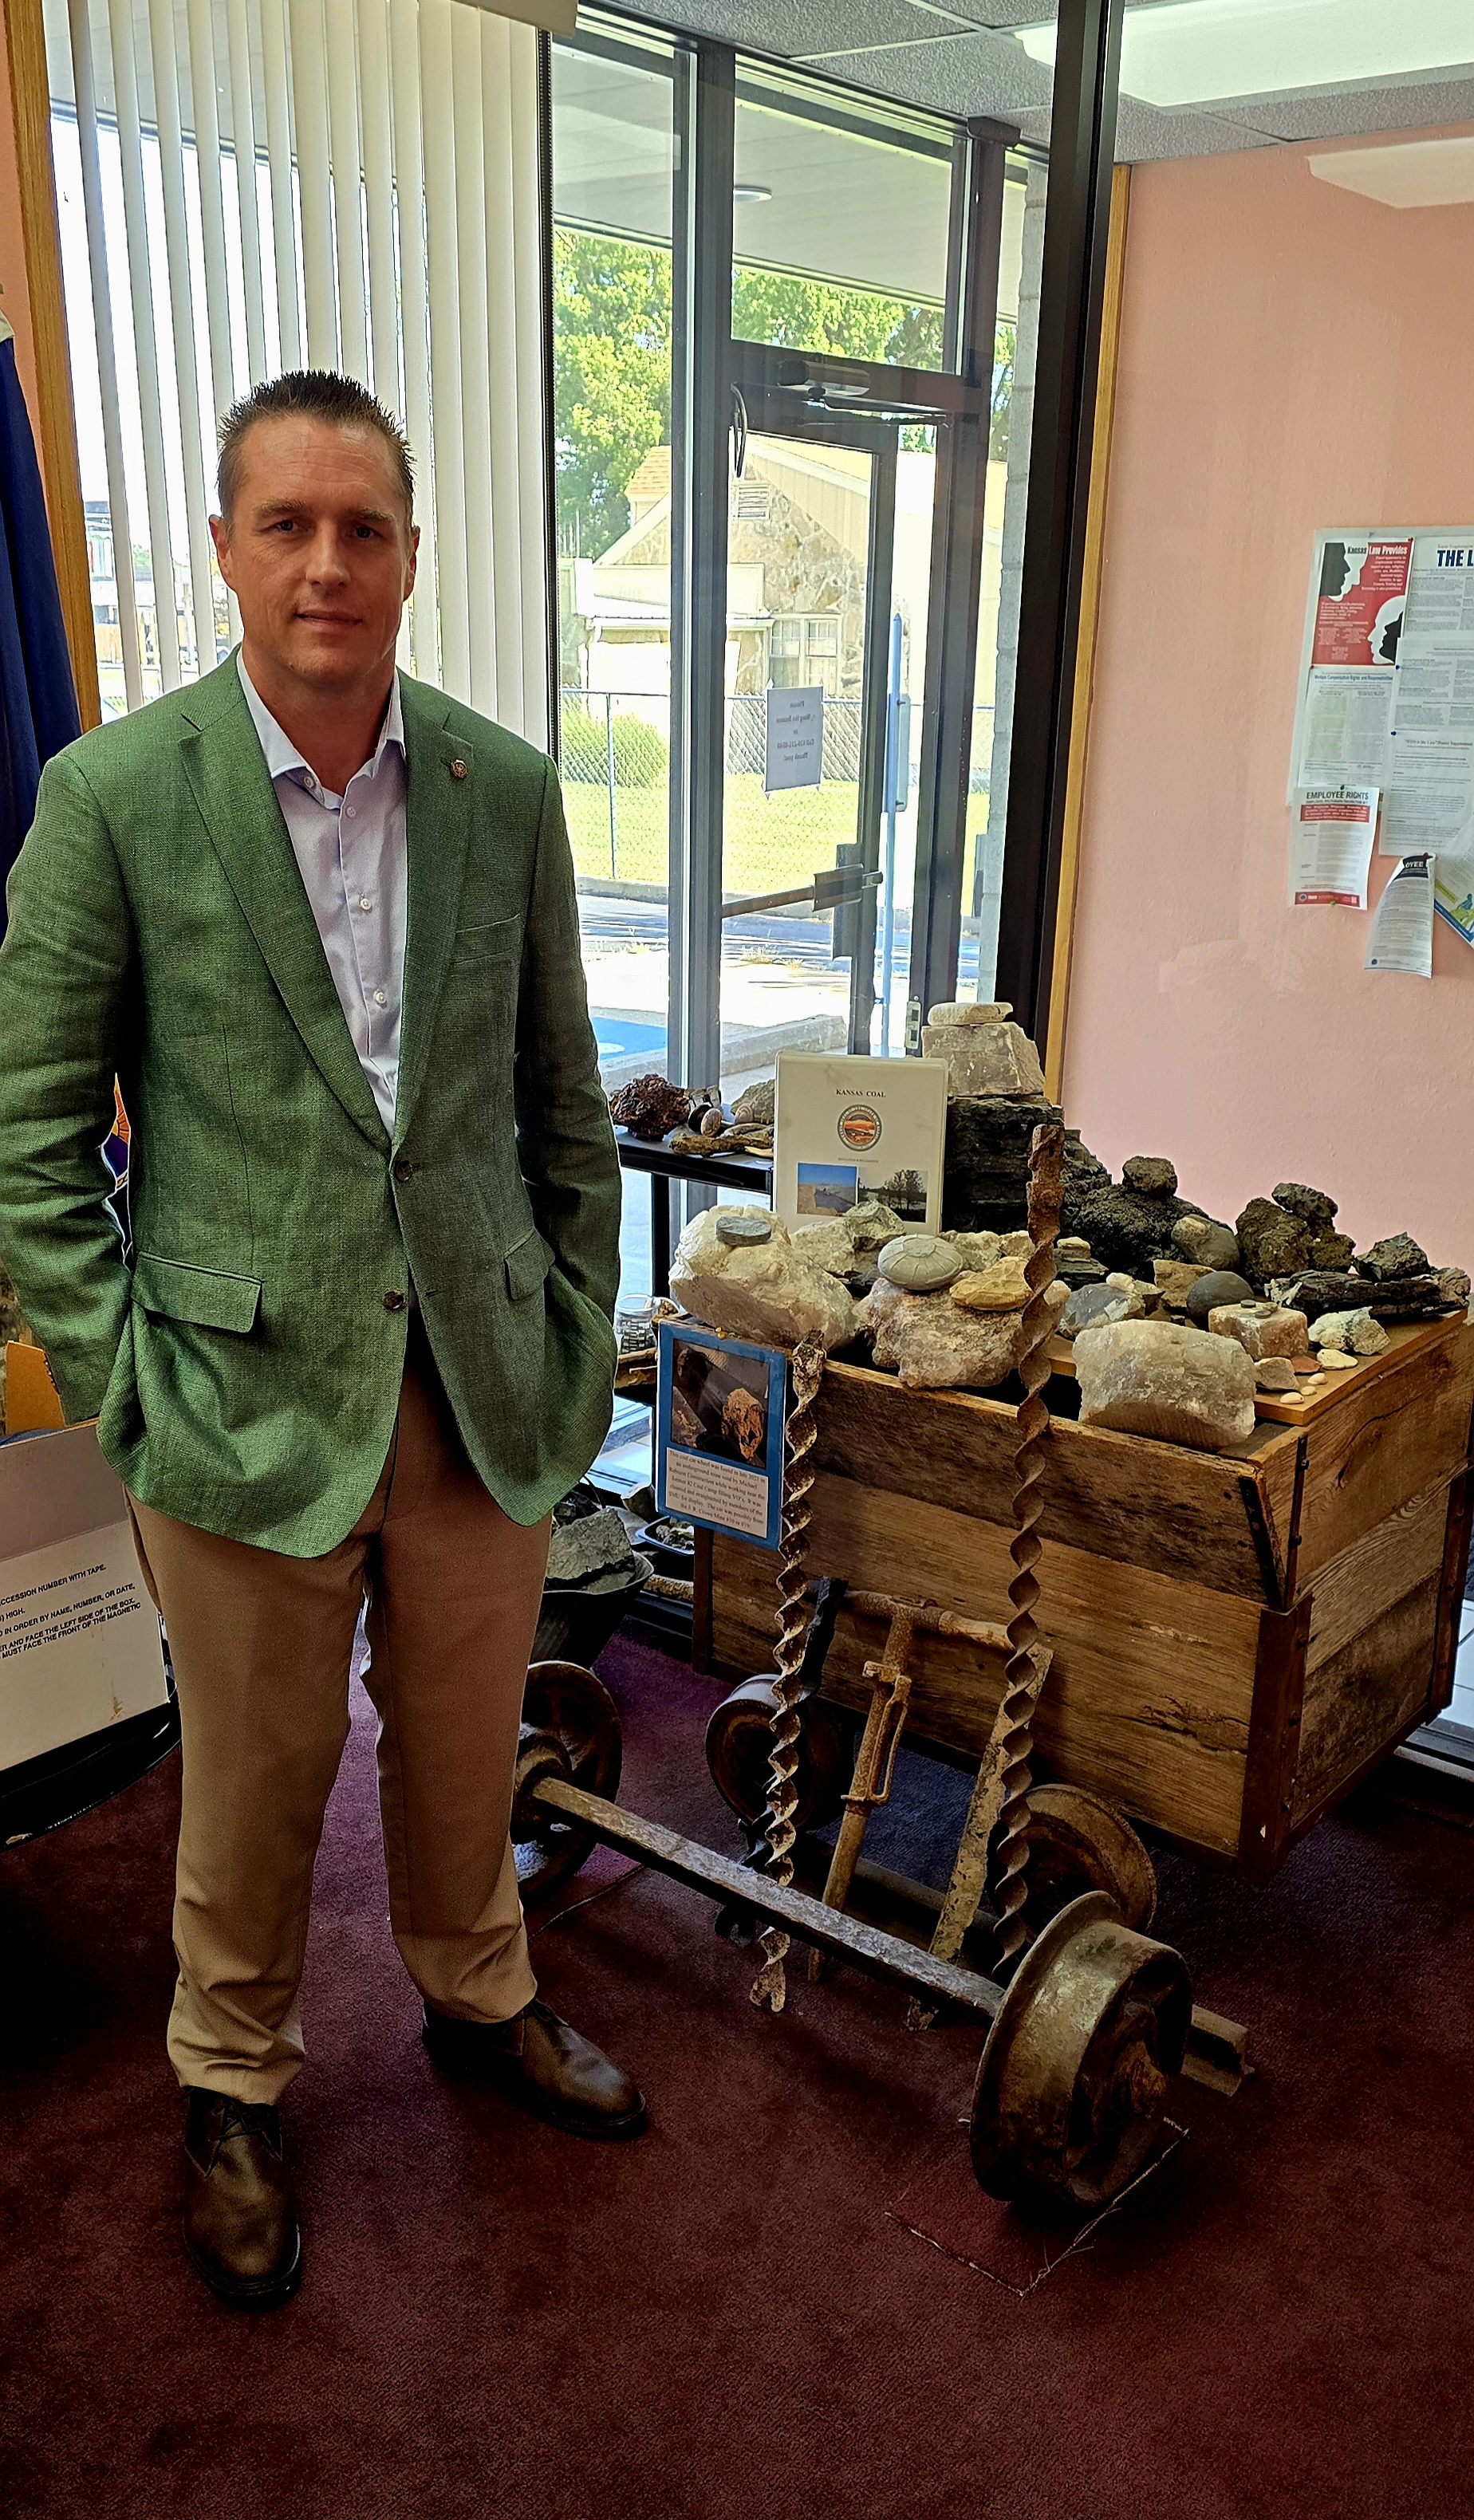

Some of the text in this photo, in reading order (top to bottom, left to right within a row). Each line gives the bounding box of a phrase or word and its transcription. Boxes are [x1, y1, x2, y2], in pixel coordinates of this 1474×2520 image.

[1369, 545, 1381, 555] Law
[1382, 545, 1407, 555] Provides
[1437, 550, 1464, 567] THE
[1346, 791, 1370, 800] RIGHTS
[682, 1463, 708, 1476] underground
[739, 1480, 757, 1489] Michael
[728, 1484, 745, 1494] working
[729, 1502, 748, 1511] members
[37, 1577, 68, 1593] NUMBER
[69, 1570, 86, 1582] WITH
[87, 1564, 107, 1576] TAPE.
[6, 1608, 26, 1620] HIGH.
[14, 1617, 38, 1631] ORDER
[39, 1613, 49, 1622] BY
[50, 1606, 73, 1619] NAME,
[73, 1594, 104, 1610] NUMBER,
[104, 1589, 116, 1598] OR
[116, 1583, 136, 1595] DATE,
[2, 1602, 141, 1659] MUST FACE THE FRONT OF THE MAGNETIC
[8, 1638, 24, 1648] AND
[25, 1630, 44, 1643] FACE
[45, 1624, 59, 1635] THE
[60, 1618, 77, 1630] LEFT
[77, 1612, 93, 1623] SIDE
[94, 1608, 104, 1616] OF
[104, 1602, 118, 1612] THE
[120, 1597, 136, 1608] BOX.
